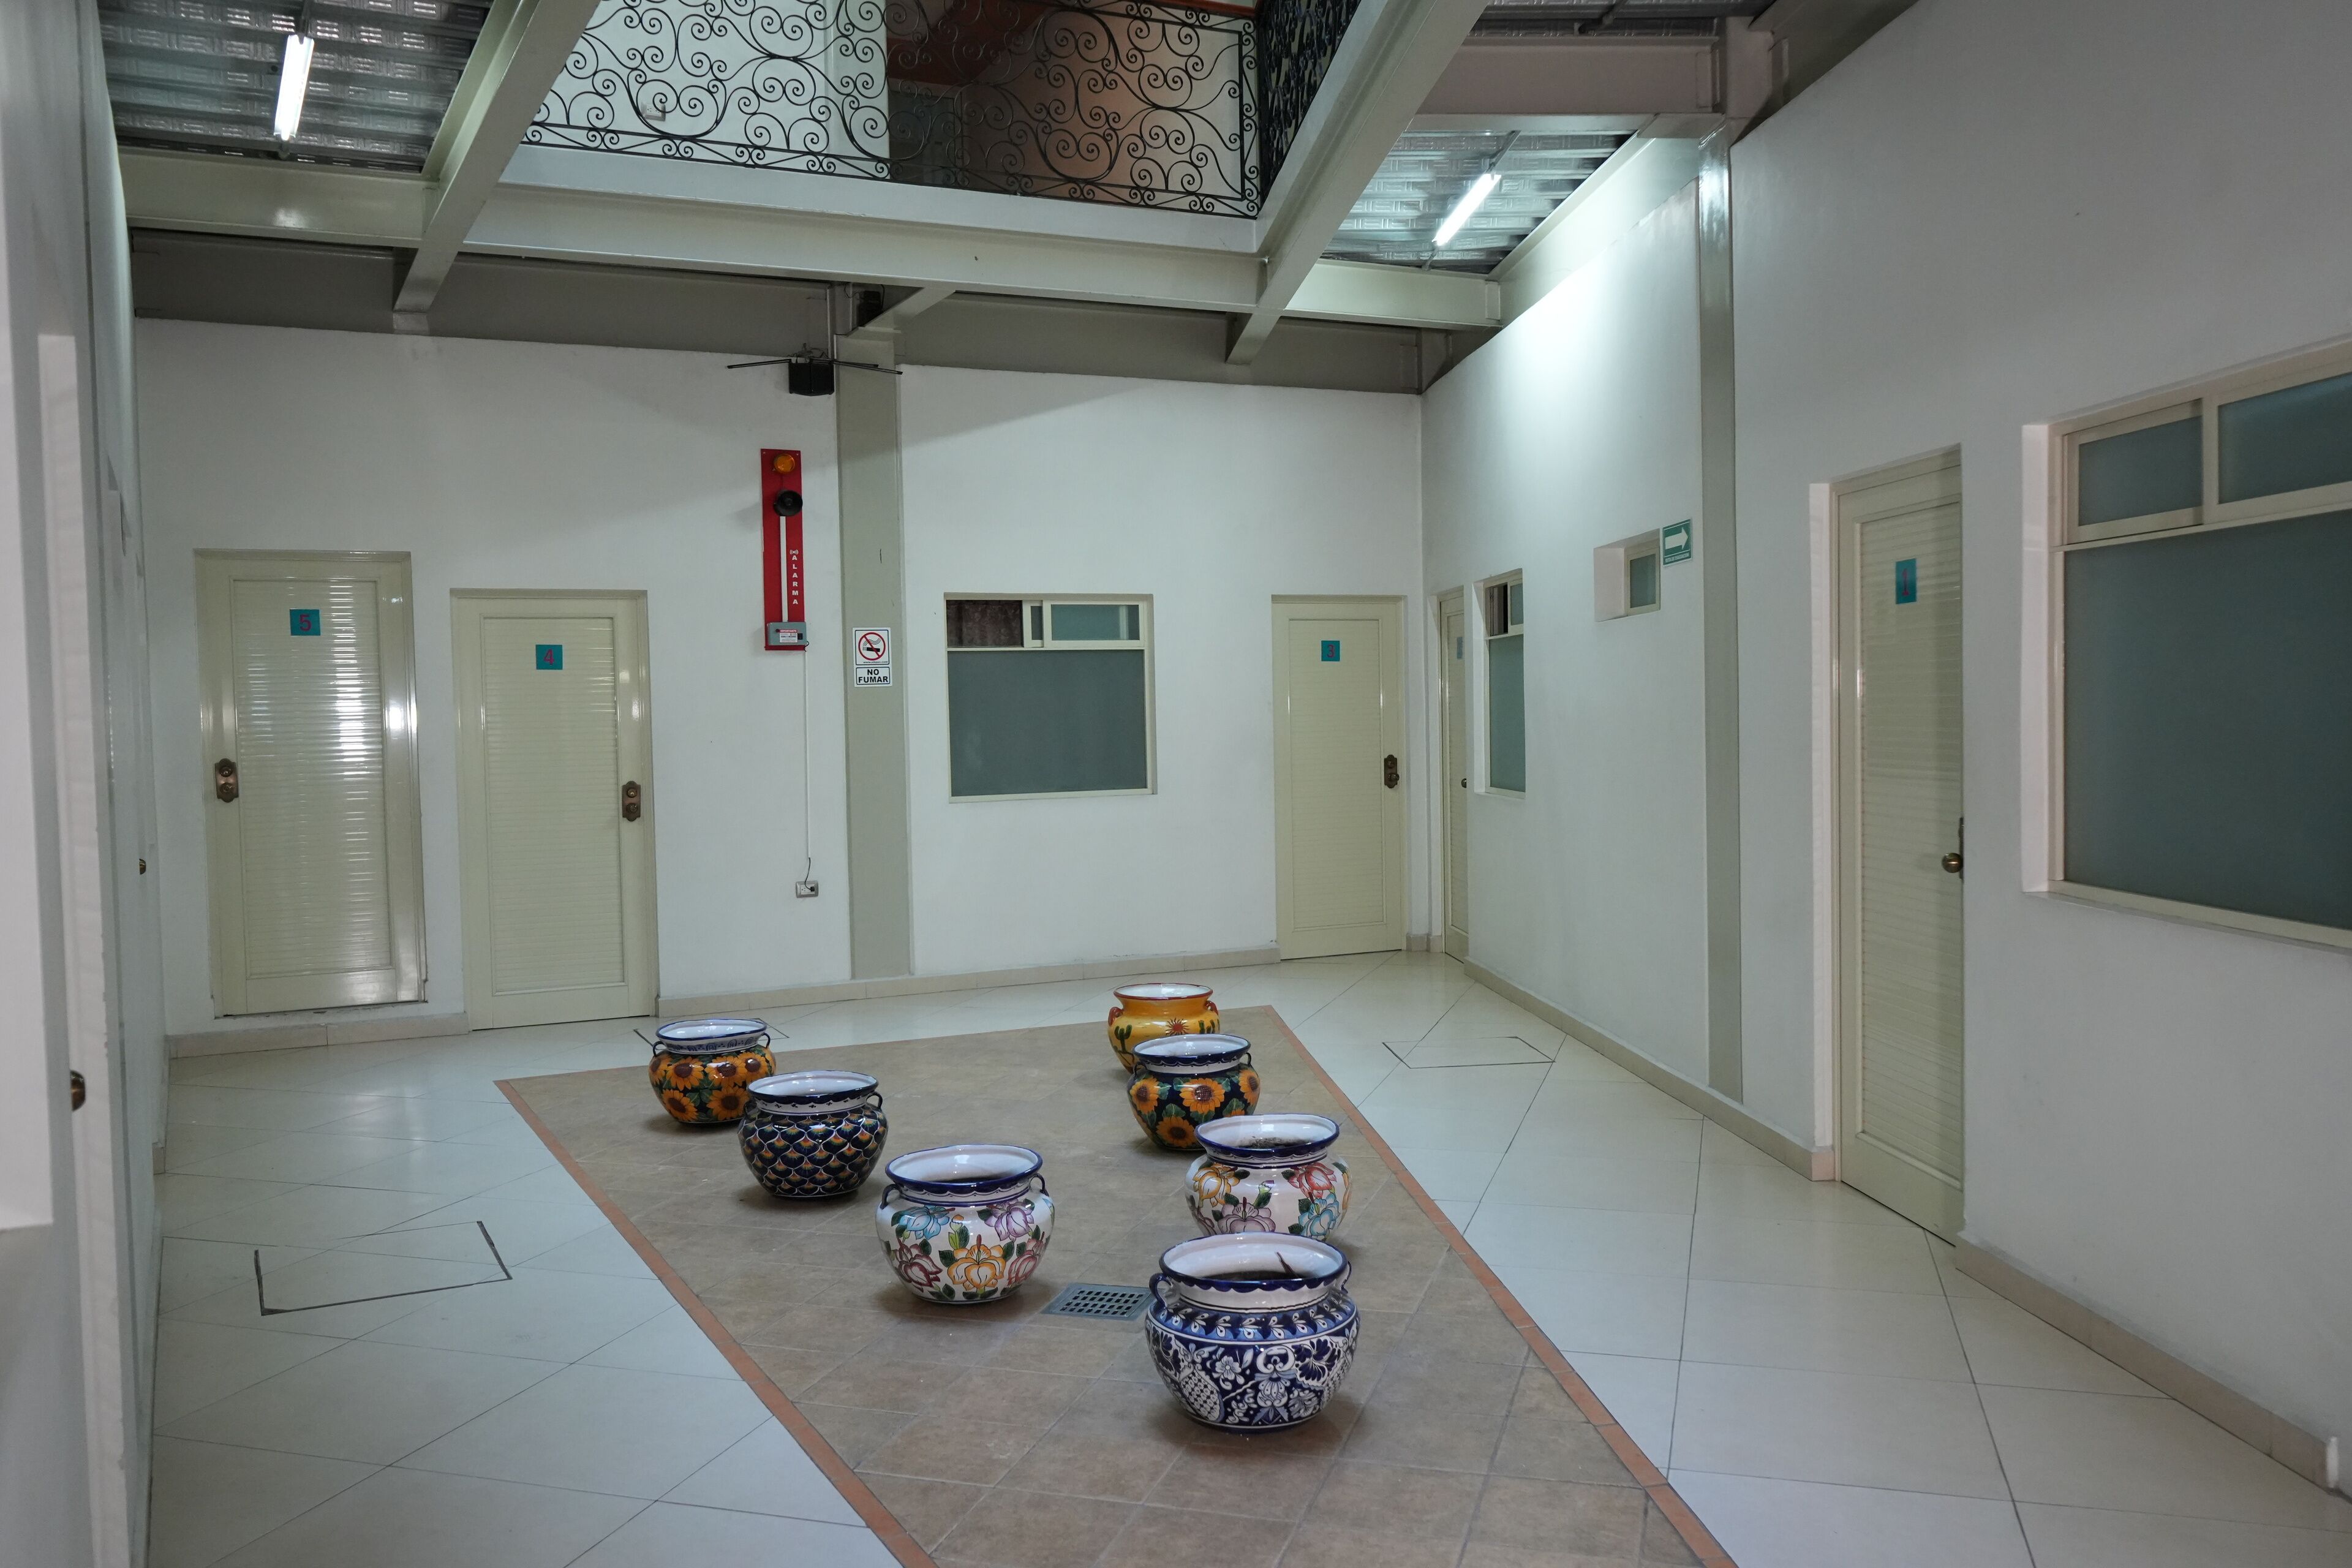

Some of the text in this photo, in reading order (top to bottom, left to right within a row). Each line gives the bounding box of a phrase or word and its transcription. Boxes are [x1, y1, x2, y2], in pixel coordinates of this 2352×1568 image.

[300, 614, 311, 631] 5
[544, 649, 554, 665] 4
[1327, 644, 1335, 658] 3
